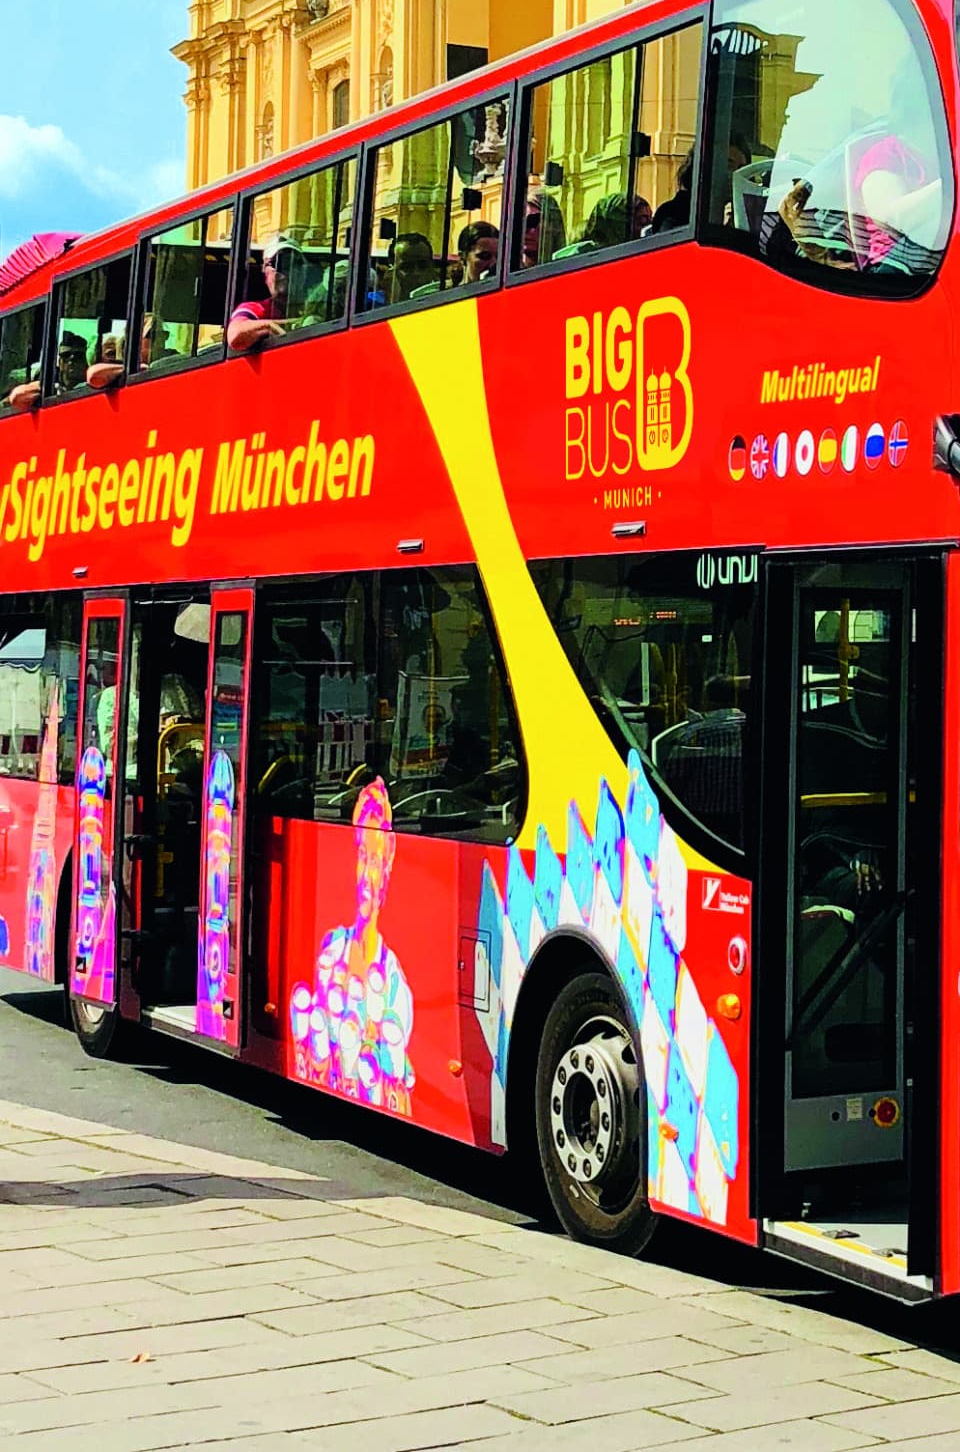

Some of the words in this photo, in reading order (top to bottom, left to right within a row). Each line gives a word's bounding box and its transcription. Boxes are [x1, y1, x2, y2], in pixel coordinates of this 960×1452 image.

[566, 306, 633, 398] BIG
[760, 356, 881, 404] Multilingual
[210, 419, 375, 514] München
[565, 399, 633, 480] BUS
[604, 486, 652, 509] MUNICH
